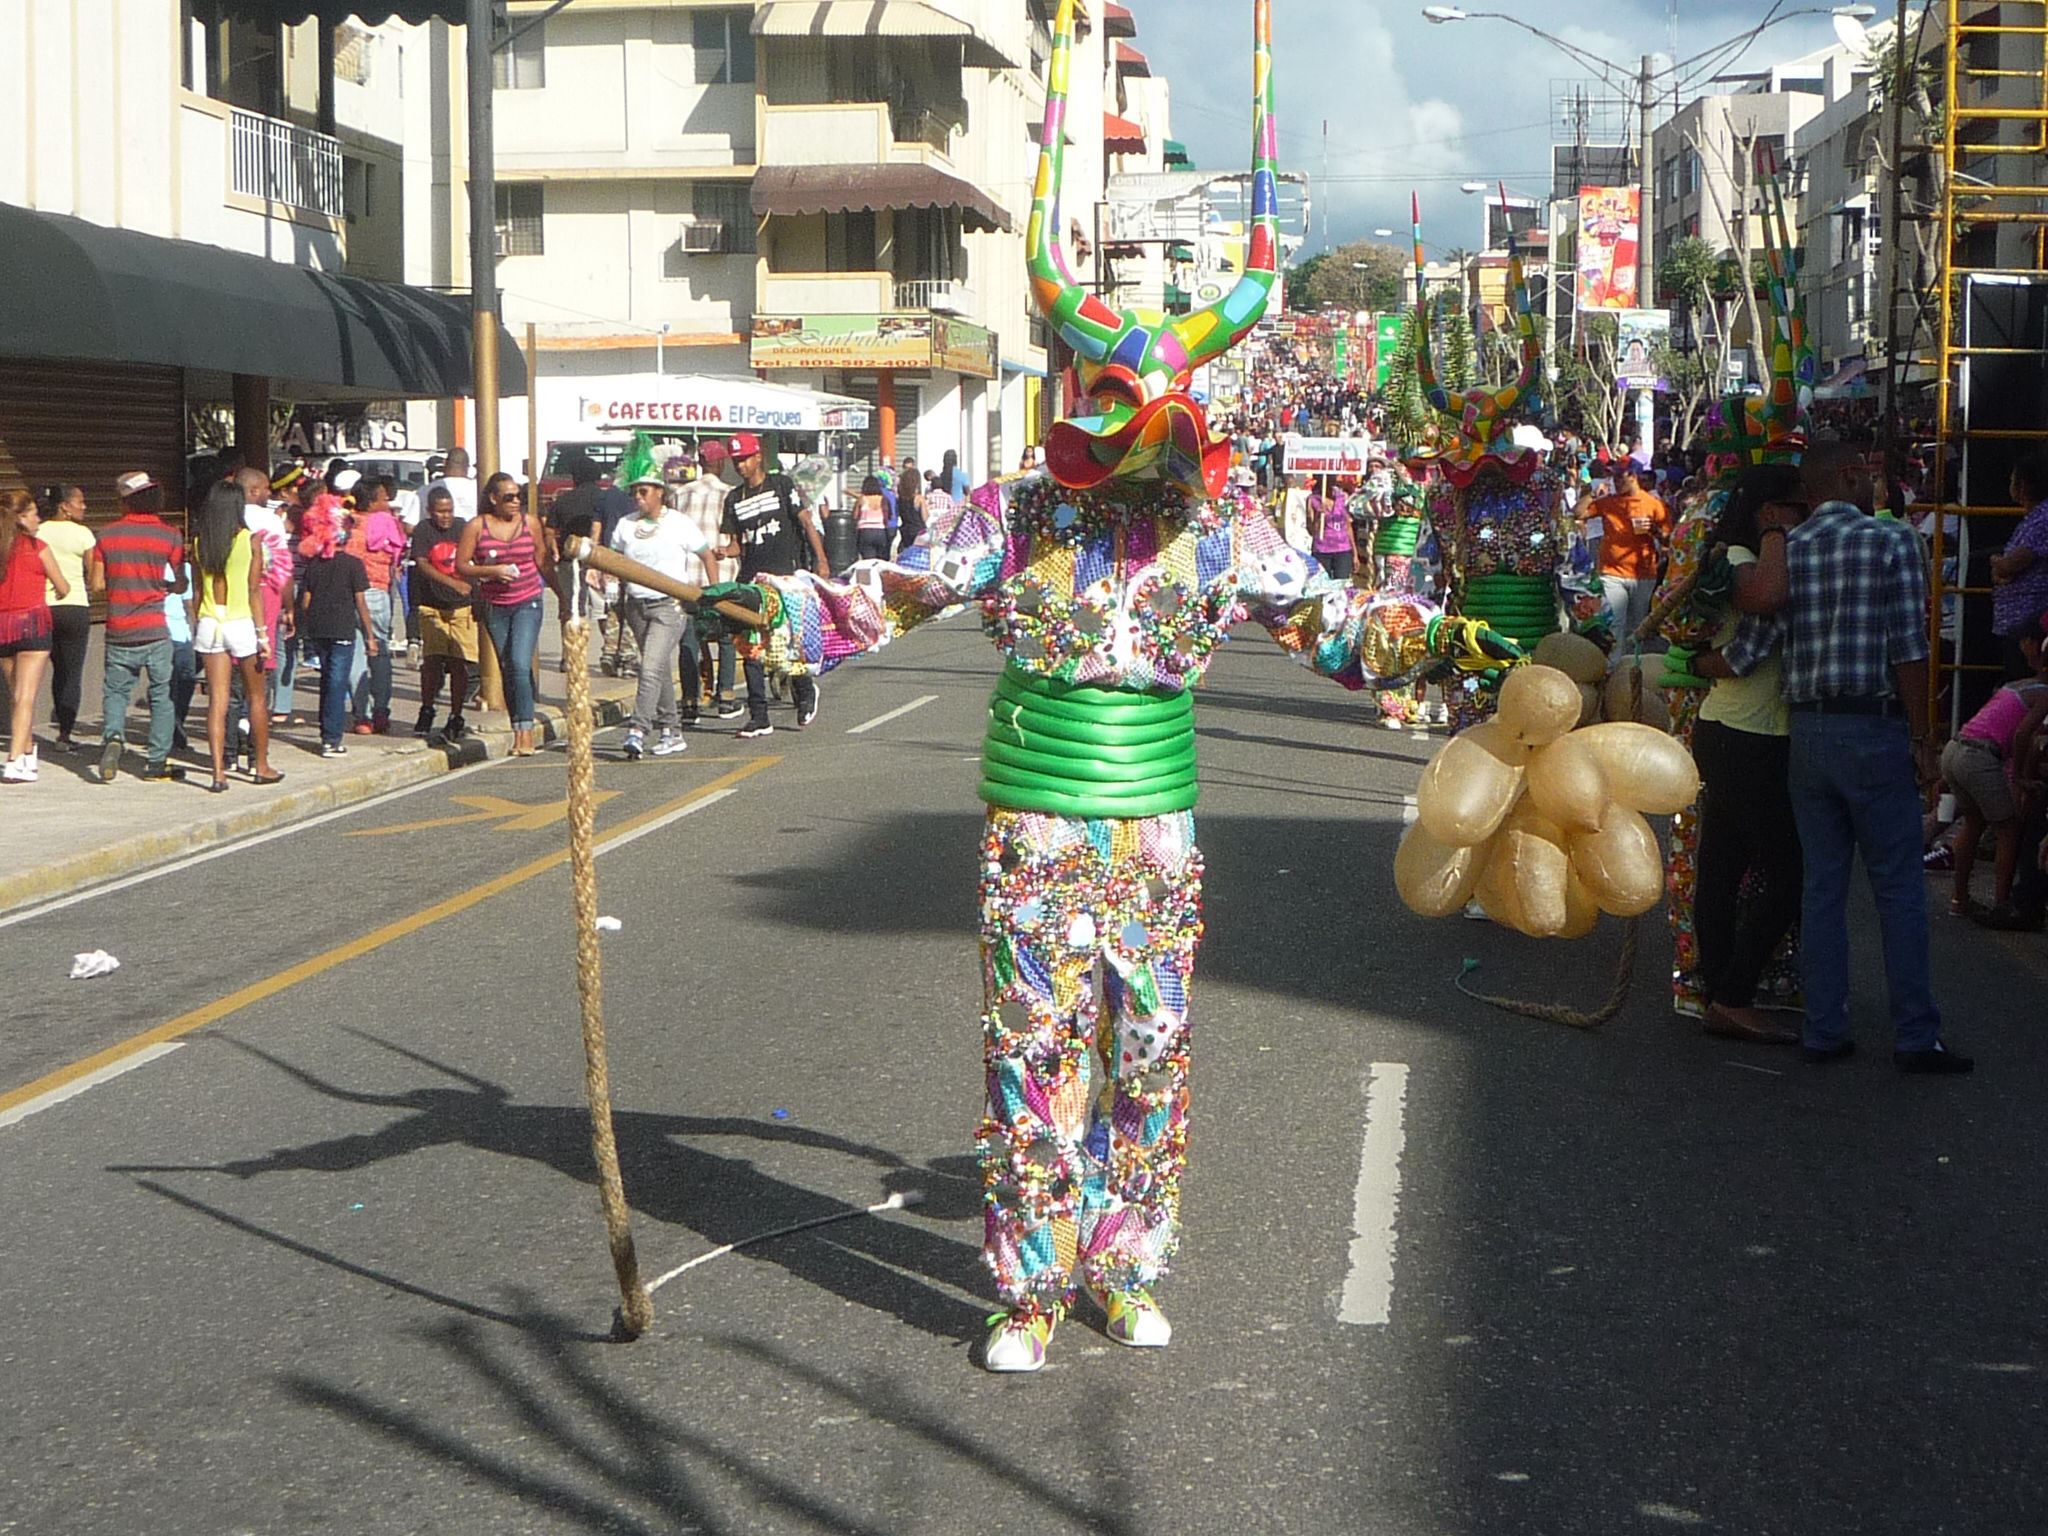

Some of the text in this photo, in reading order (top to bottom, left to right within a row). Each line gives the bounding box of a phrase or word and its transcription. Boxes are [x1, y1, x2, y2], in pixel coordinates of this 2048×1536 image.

[753, 359, 930, 367] Tel.: 809-582-4003
[608, 401, 722, 422] CAFETERIA
[729, 405, 744, 423] El
[748, 405, 802, 427] Parqueo
[276, 419, 406, 454] ARLOS
